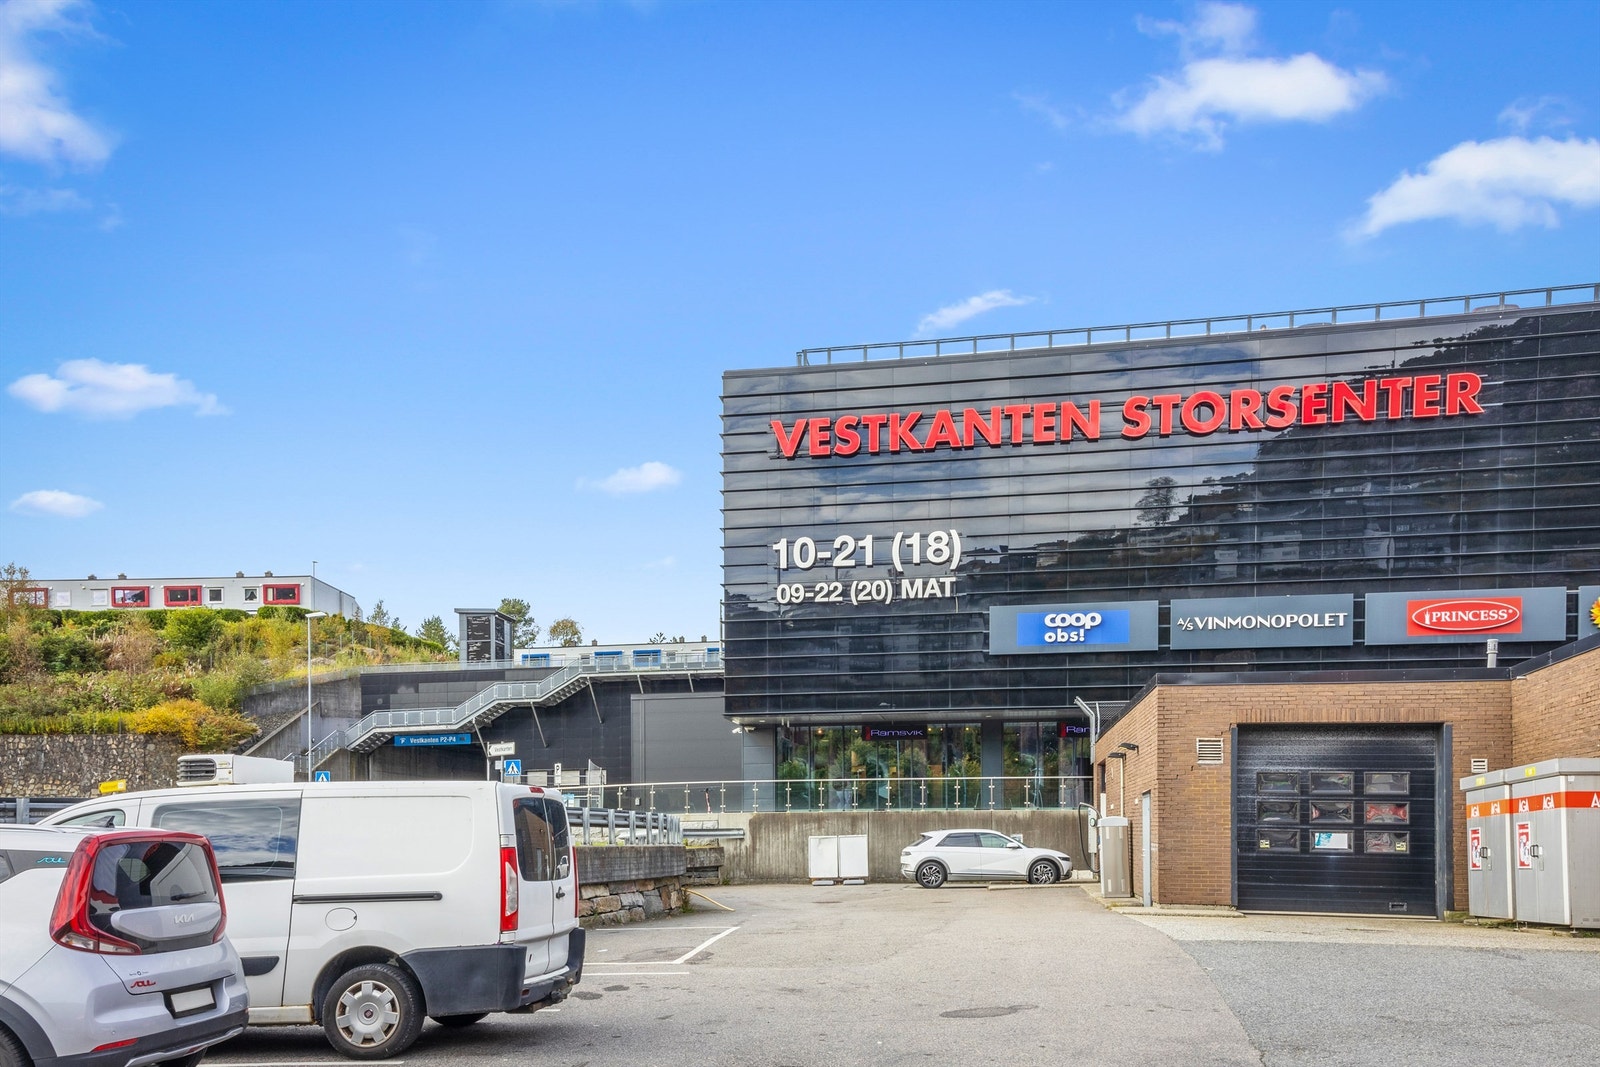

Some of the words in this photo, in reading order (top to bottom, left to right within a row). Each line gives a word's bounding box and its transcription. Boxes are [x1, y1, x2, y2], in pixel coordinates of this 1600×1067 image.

[770, 399, 1102, 458] VESTKANTEN
[1121, 372, 1485, 438] STORSENTER
[772, 533, 876, 571] 10-21
[892, 528, 963, 573] (18)
[776, 581, 843, 604] 09-22
[850, 579, 894, 606] (20)
[901, 577, 956, 599] MAT
[1194, 613, 1348, 630] VINMONOPOLET
[1044, 629, 1086, 643] obs!
[409, 736, 439, 744] Vestkanten
[439, 735, 457, 743] P2-P4
[870, 729, 924, 737] Ramsvik
